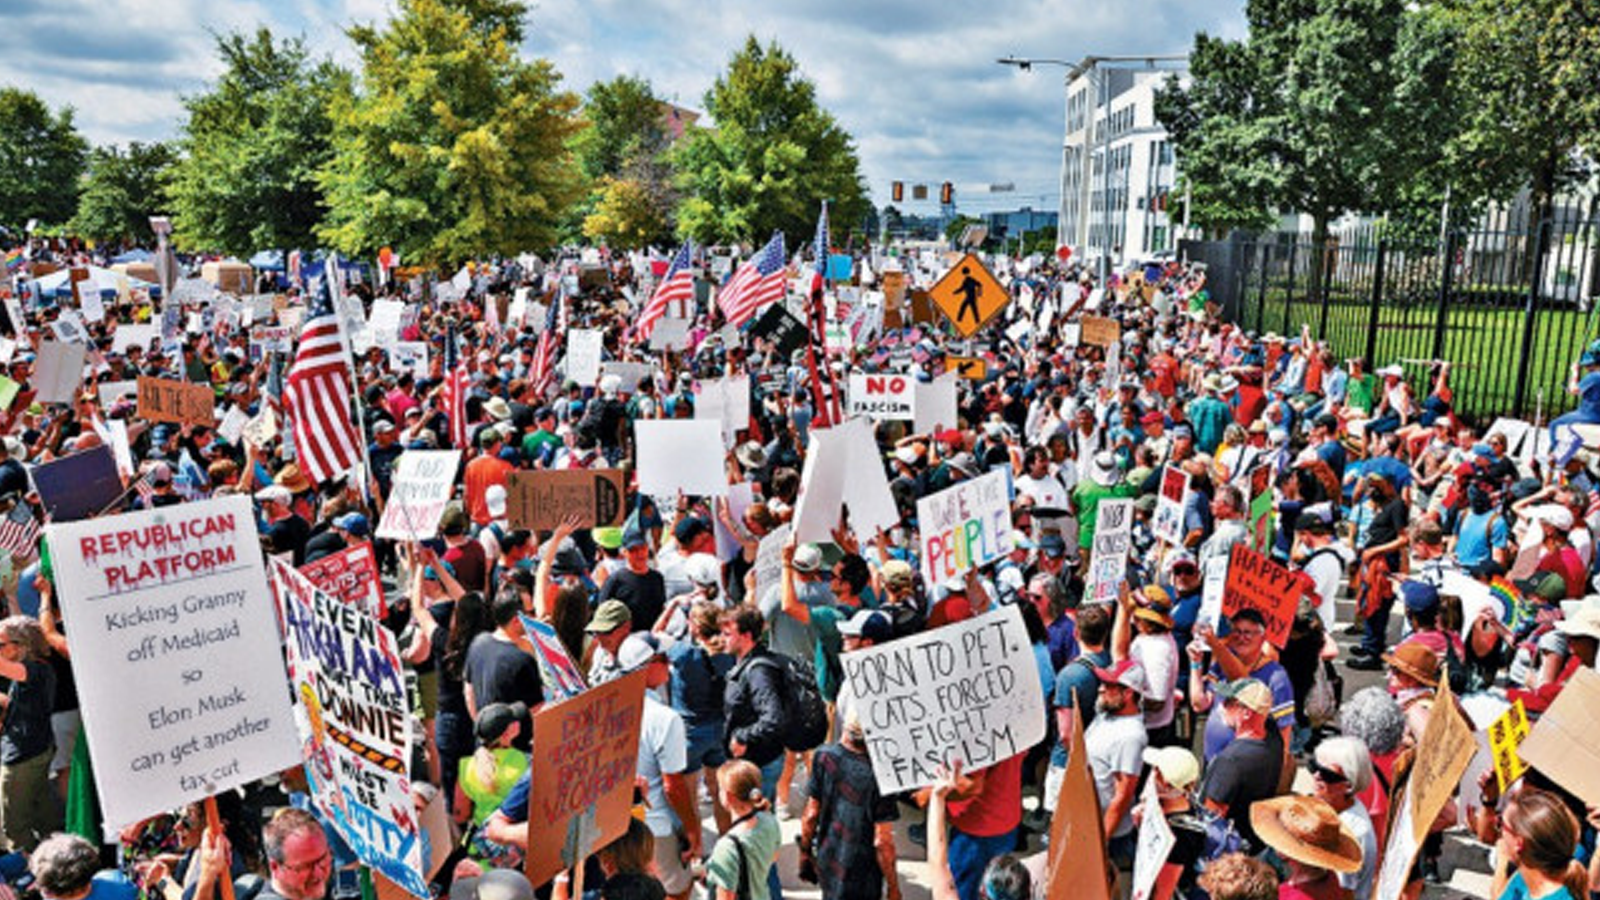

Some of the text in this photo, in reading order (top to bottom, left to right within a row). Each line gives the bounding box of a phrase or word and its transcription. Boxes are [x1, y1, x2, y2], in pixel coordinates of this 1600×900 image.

[854, 401, 911, 413] FASCISM
[866, 377, 906, 395] NO
[79, 514, 236, 562] REPUBLICAN
[927, 509, 1008, 583] PEOPLE
[104, 545, 236, 589] PLATFORM
[1235, 546, 1298, 593] HAPPY
[105, 590, 247, 631] Kicking Granny
[314, 590, 376, 645] EVEN
[127, 620, 240, 662] off Medicaid
[285, 590, 403, 698] ARKHAM
[181, 669, 203, 684] so
[847, 647, 917, 699] BORN
[916, 640, 955, 680] TO
[936, 665, 1015, 715] FORCED
[148, 687, 247, 730] Elon Musk
[316, 672, 405, 748] DONNIE
[131, 717, 271, 772] can get another
[866, 703, 991, 763] TO FIGHT
[179, 759, 240, 791] tax cut
[340, 755, 388, 793] MUST
[356, 785, 379, 810] BE
